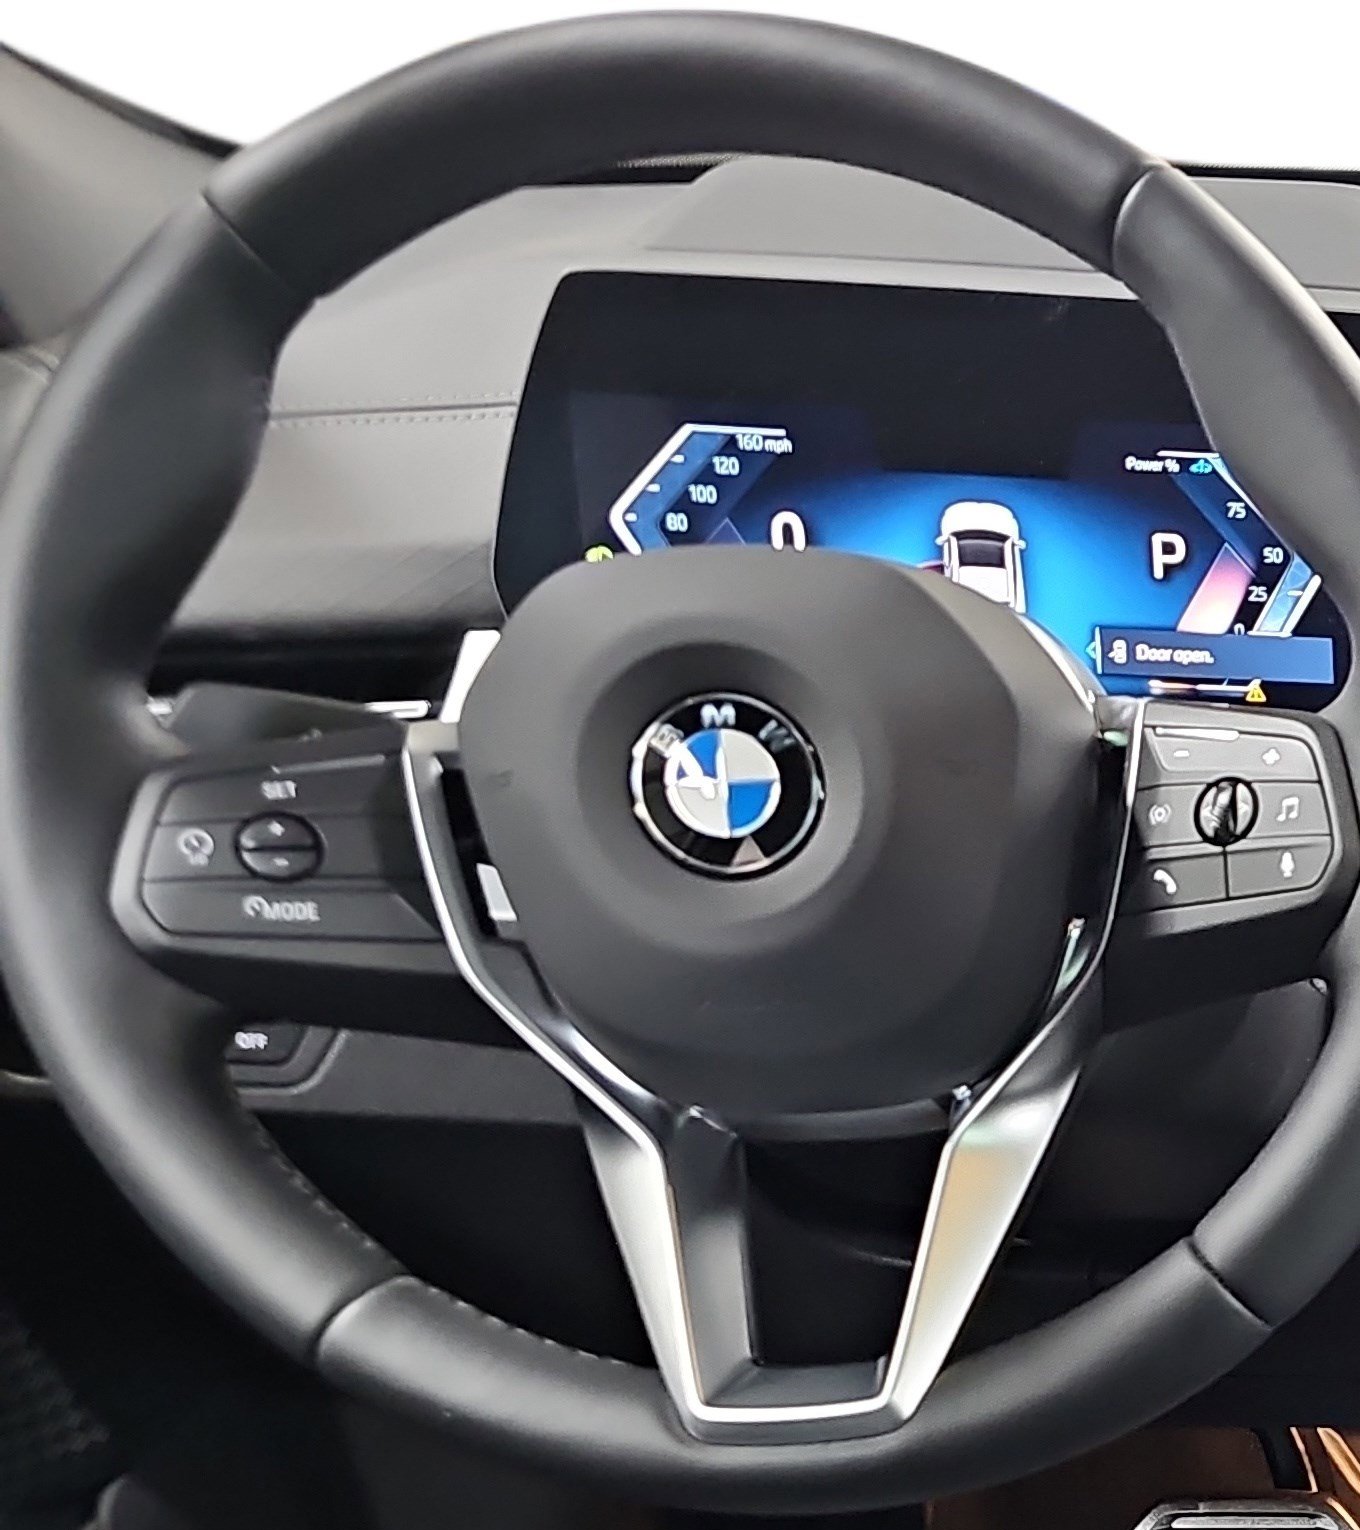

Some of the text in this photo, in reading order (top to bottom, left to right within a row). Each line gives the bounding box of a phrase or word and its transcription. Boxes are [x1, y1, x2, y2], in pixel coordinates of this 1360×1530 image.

[735, 434, 793, 454] 160 mph
[712, 456, 740, 475] 120
[1125, 456, 1163, 472] Power
[688, 484, 717, 504] 100
[1226, 501, 1246, 519] 75
[665, 512, 688, 532] 80
[1151, 532, 1187, 580] P
[1263, 547, 1283, 564] 50
[1248, 586, 1267, 602] 25
[1135, 644, 1215, 665] Door open.
[650, 703, 797, 758] BMW
[263, 901, 320, 922] MODE
